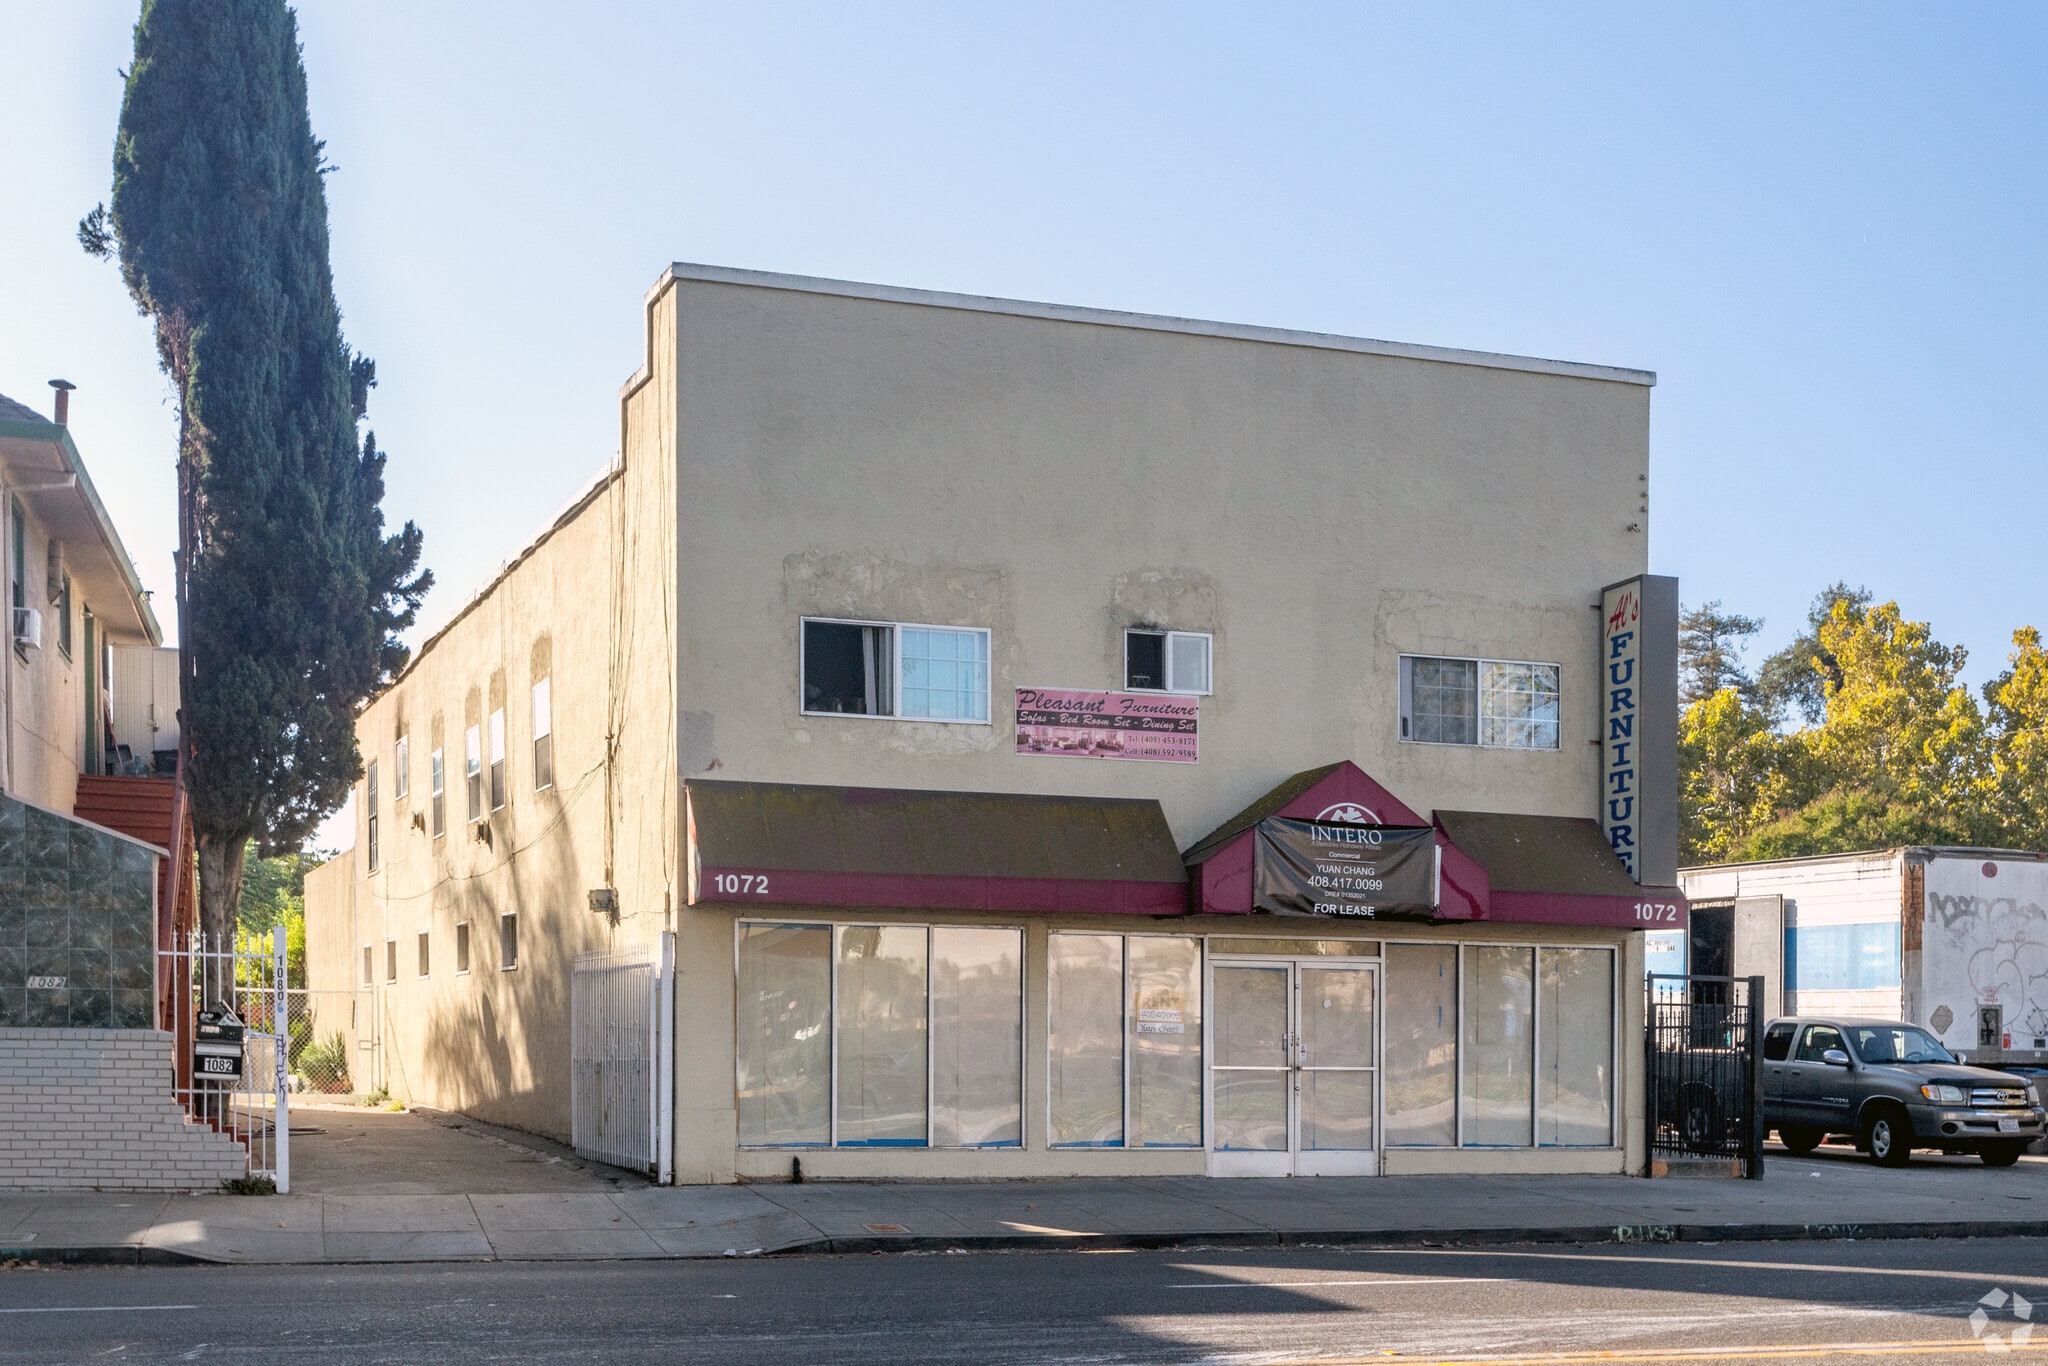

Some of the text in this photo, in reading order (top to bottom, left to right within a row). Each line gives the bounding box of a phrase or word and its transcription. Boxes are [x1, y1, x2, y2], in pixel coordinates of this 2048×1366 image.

[1607, 591, 1639, 637] Al's
[1018, 689, 1197, 715] Pleasant Furniture
[1019, 711, 1047, 723] Sofas
[1060, 713, 1078, 724] Bed
[1083, 715, 1110, 726] Room
[1114, 717, 1130, 727] Set
[1142, 718, 1175, 731] Dining
[1178, 720, 1195, 731] Set
[1141, 736, 1160, 744] (408)
[1141, 748, 1160, 756] (408)
[1311, 826, 1382, 845] INTERO
[1329, 851, 1361, 859] Commercial
[1316, 864, 1375, 876] YUAN CHANG
[715, 874, 769, 894] 1072
[1307, 876, 1383, 890] 408.417.0099
[1314, 903, 1375, 915] FOR LEASE
[1633, 902, 1677, 922] 1072
[29, 976, 66, 988] 1082
[1141, 996, 1180, 1008] RENT
[1140, 1023, 1156, 1032] Yuan
[205, 1059, 233, 1072] 1082
